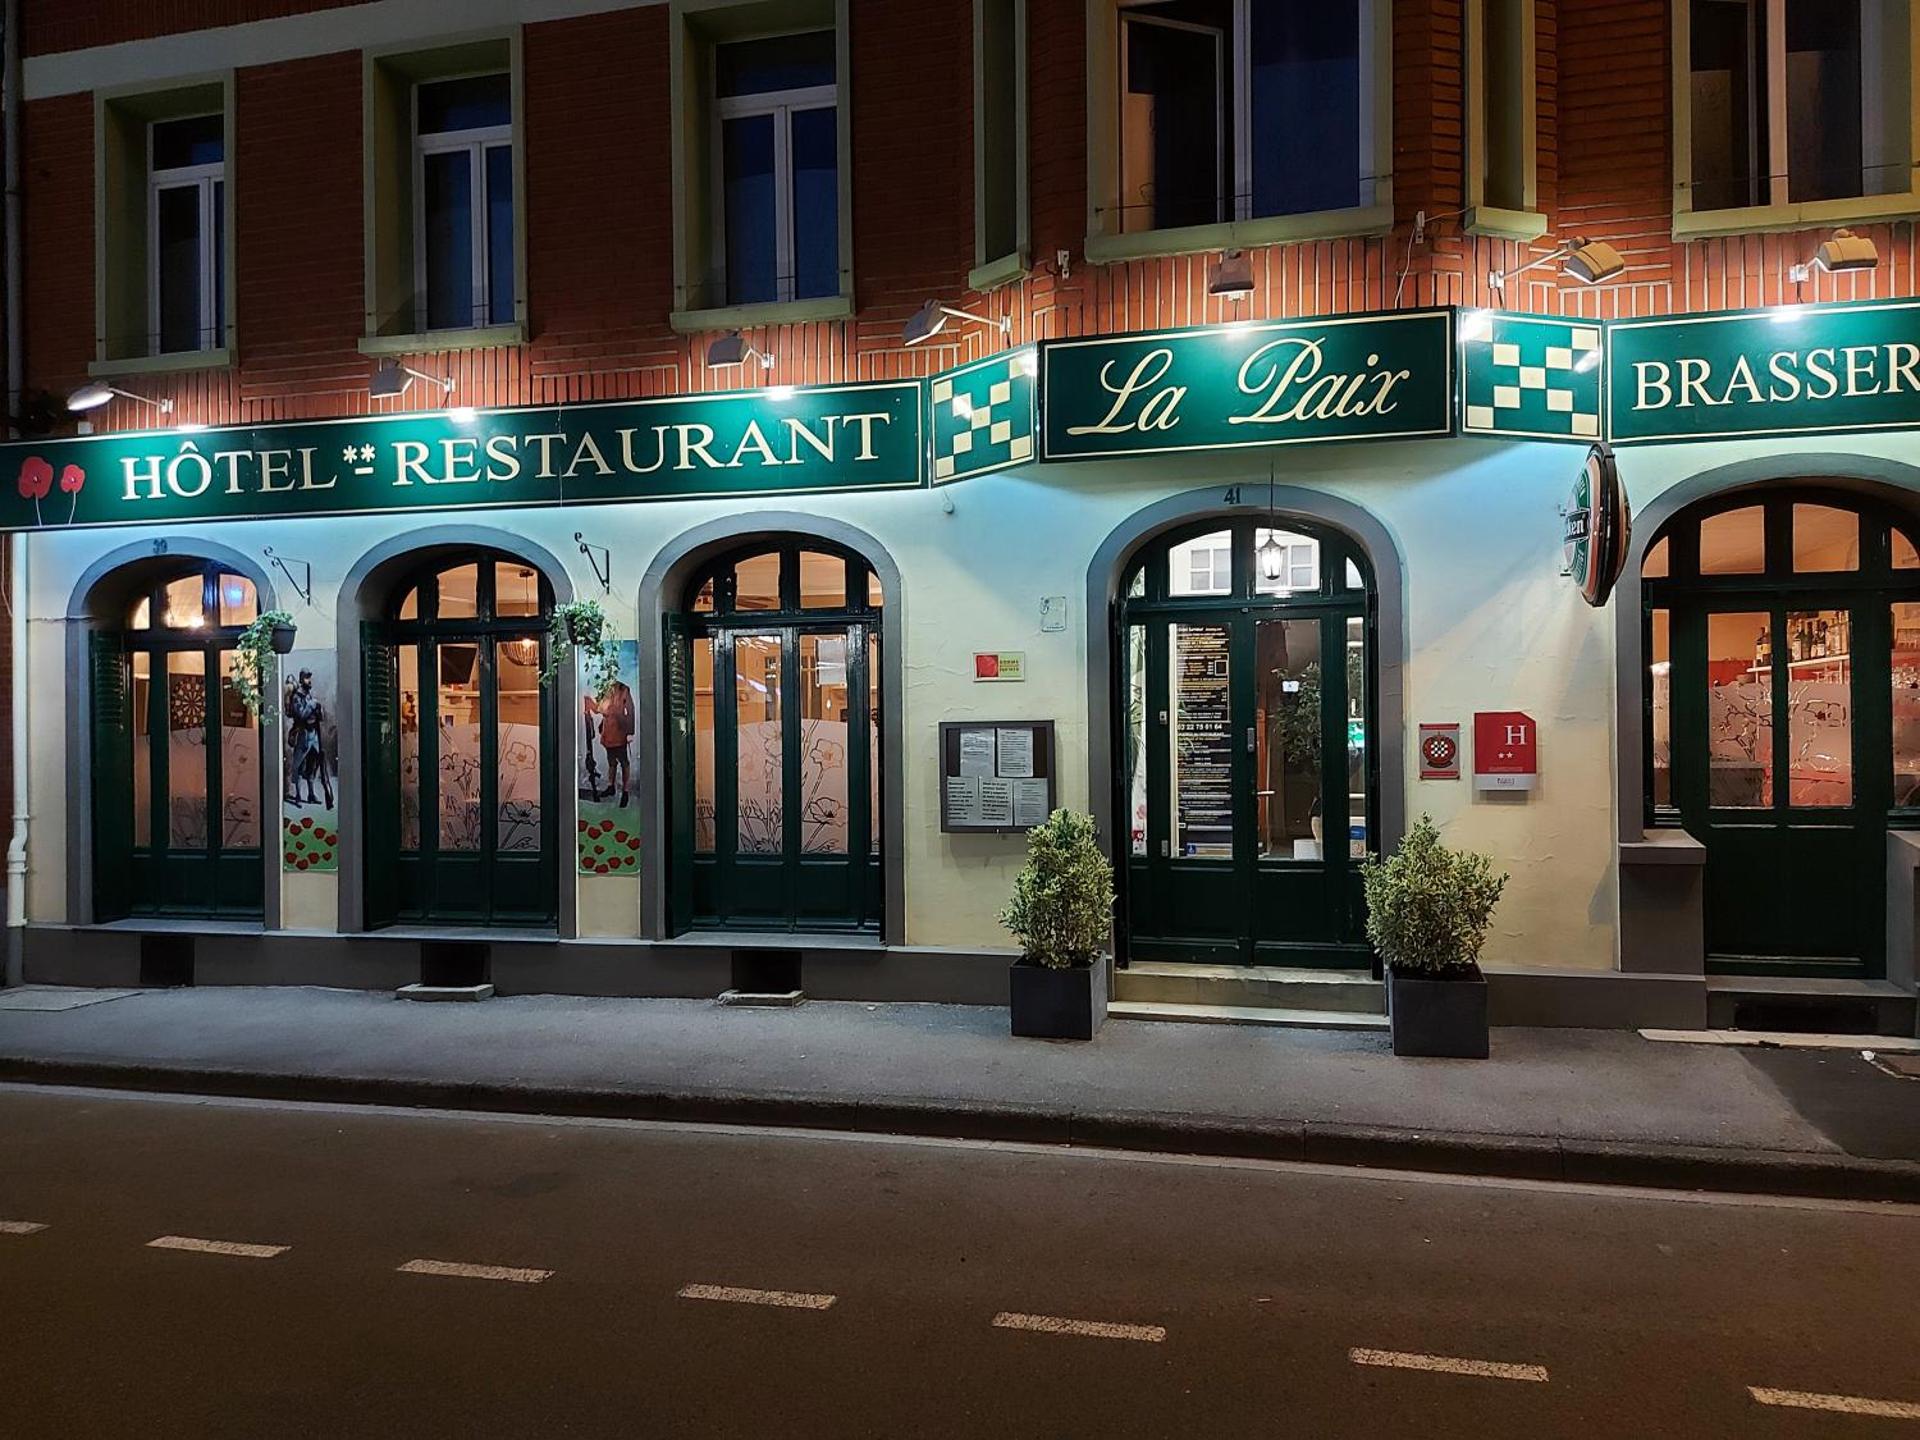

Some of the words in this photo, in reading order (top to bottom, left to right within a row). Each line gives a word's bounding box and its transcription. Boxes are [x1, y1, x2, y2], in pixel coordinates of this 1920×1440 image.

[1066, 348, 1187, 434] La
[1228, 336, 1410, 425] Paix
[1631, 342, 1920, 411] BRASSER
[119, 441, 337, 501] HÔTEL
[391, 412, 890, 487] RESTAURANT
[1223, 488, 1241, 506] 41
[1504, 724, 1528, 746] H
